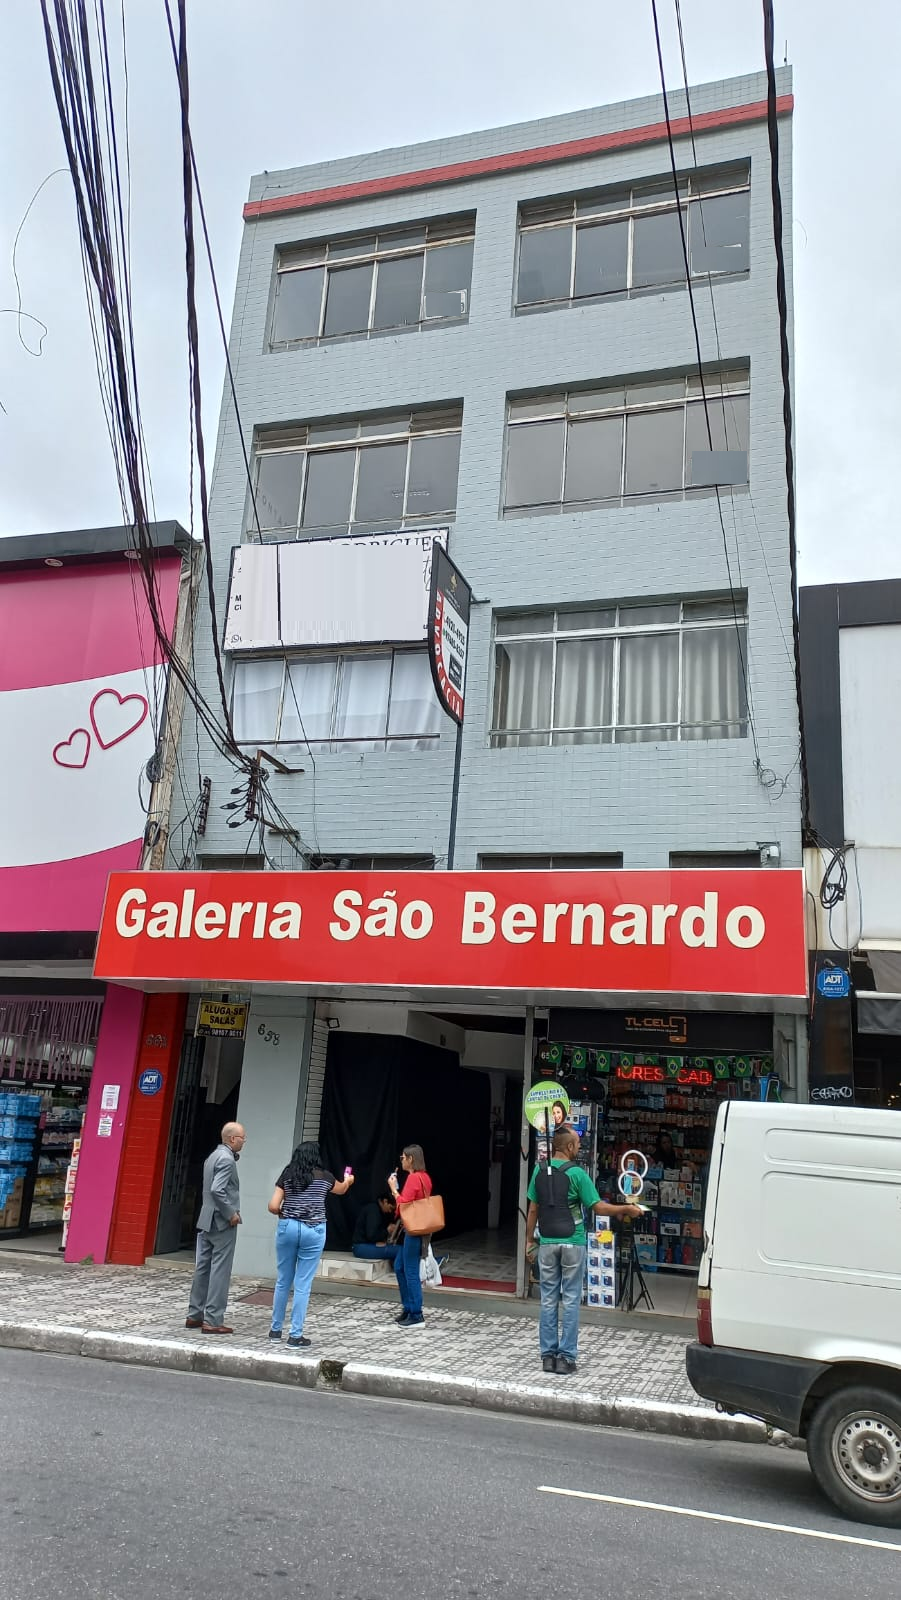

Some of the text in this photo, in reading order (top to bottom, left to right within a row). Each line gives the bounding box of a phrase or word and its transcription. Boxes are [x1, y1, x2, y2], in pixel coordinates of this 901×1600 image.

[329, 889, 434, 941] São
[461, 891, 766, 949] Bernardo
[825, 975, 843, 984] ADT
[204, 1004, 245, 1016] ALUGA-SE
[209, 1015, 236, 1026] SALAS
[258, 1024, 280, 1045] 658
[143, 1075, 158, 1084] ADT
